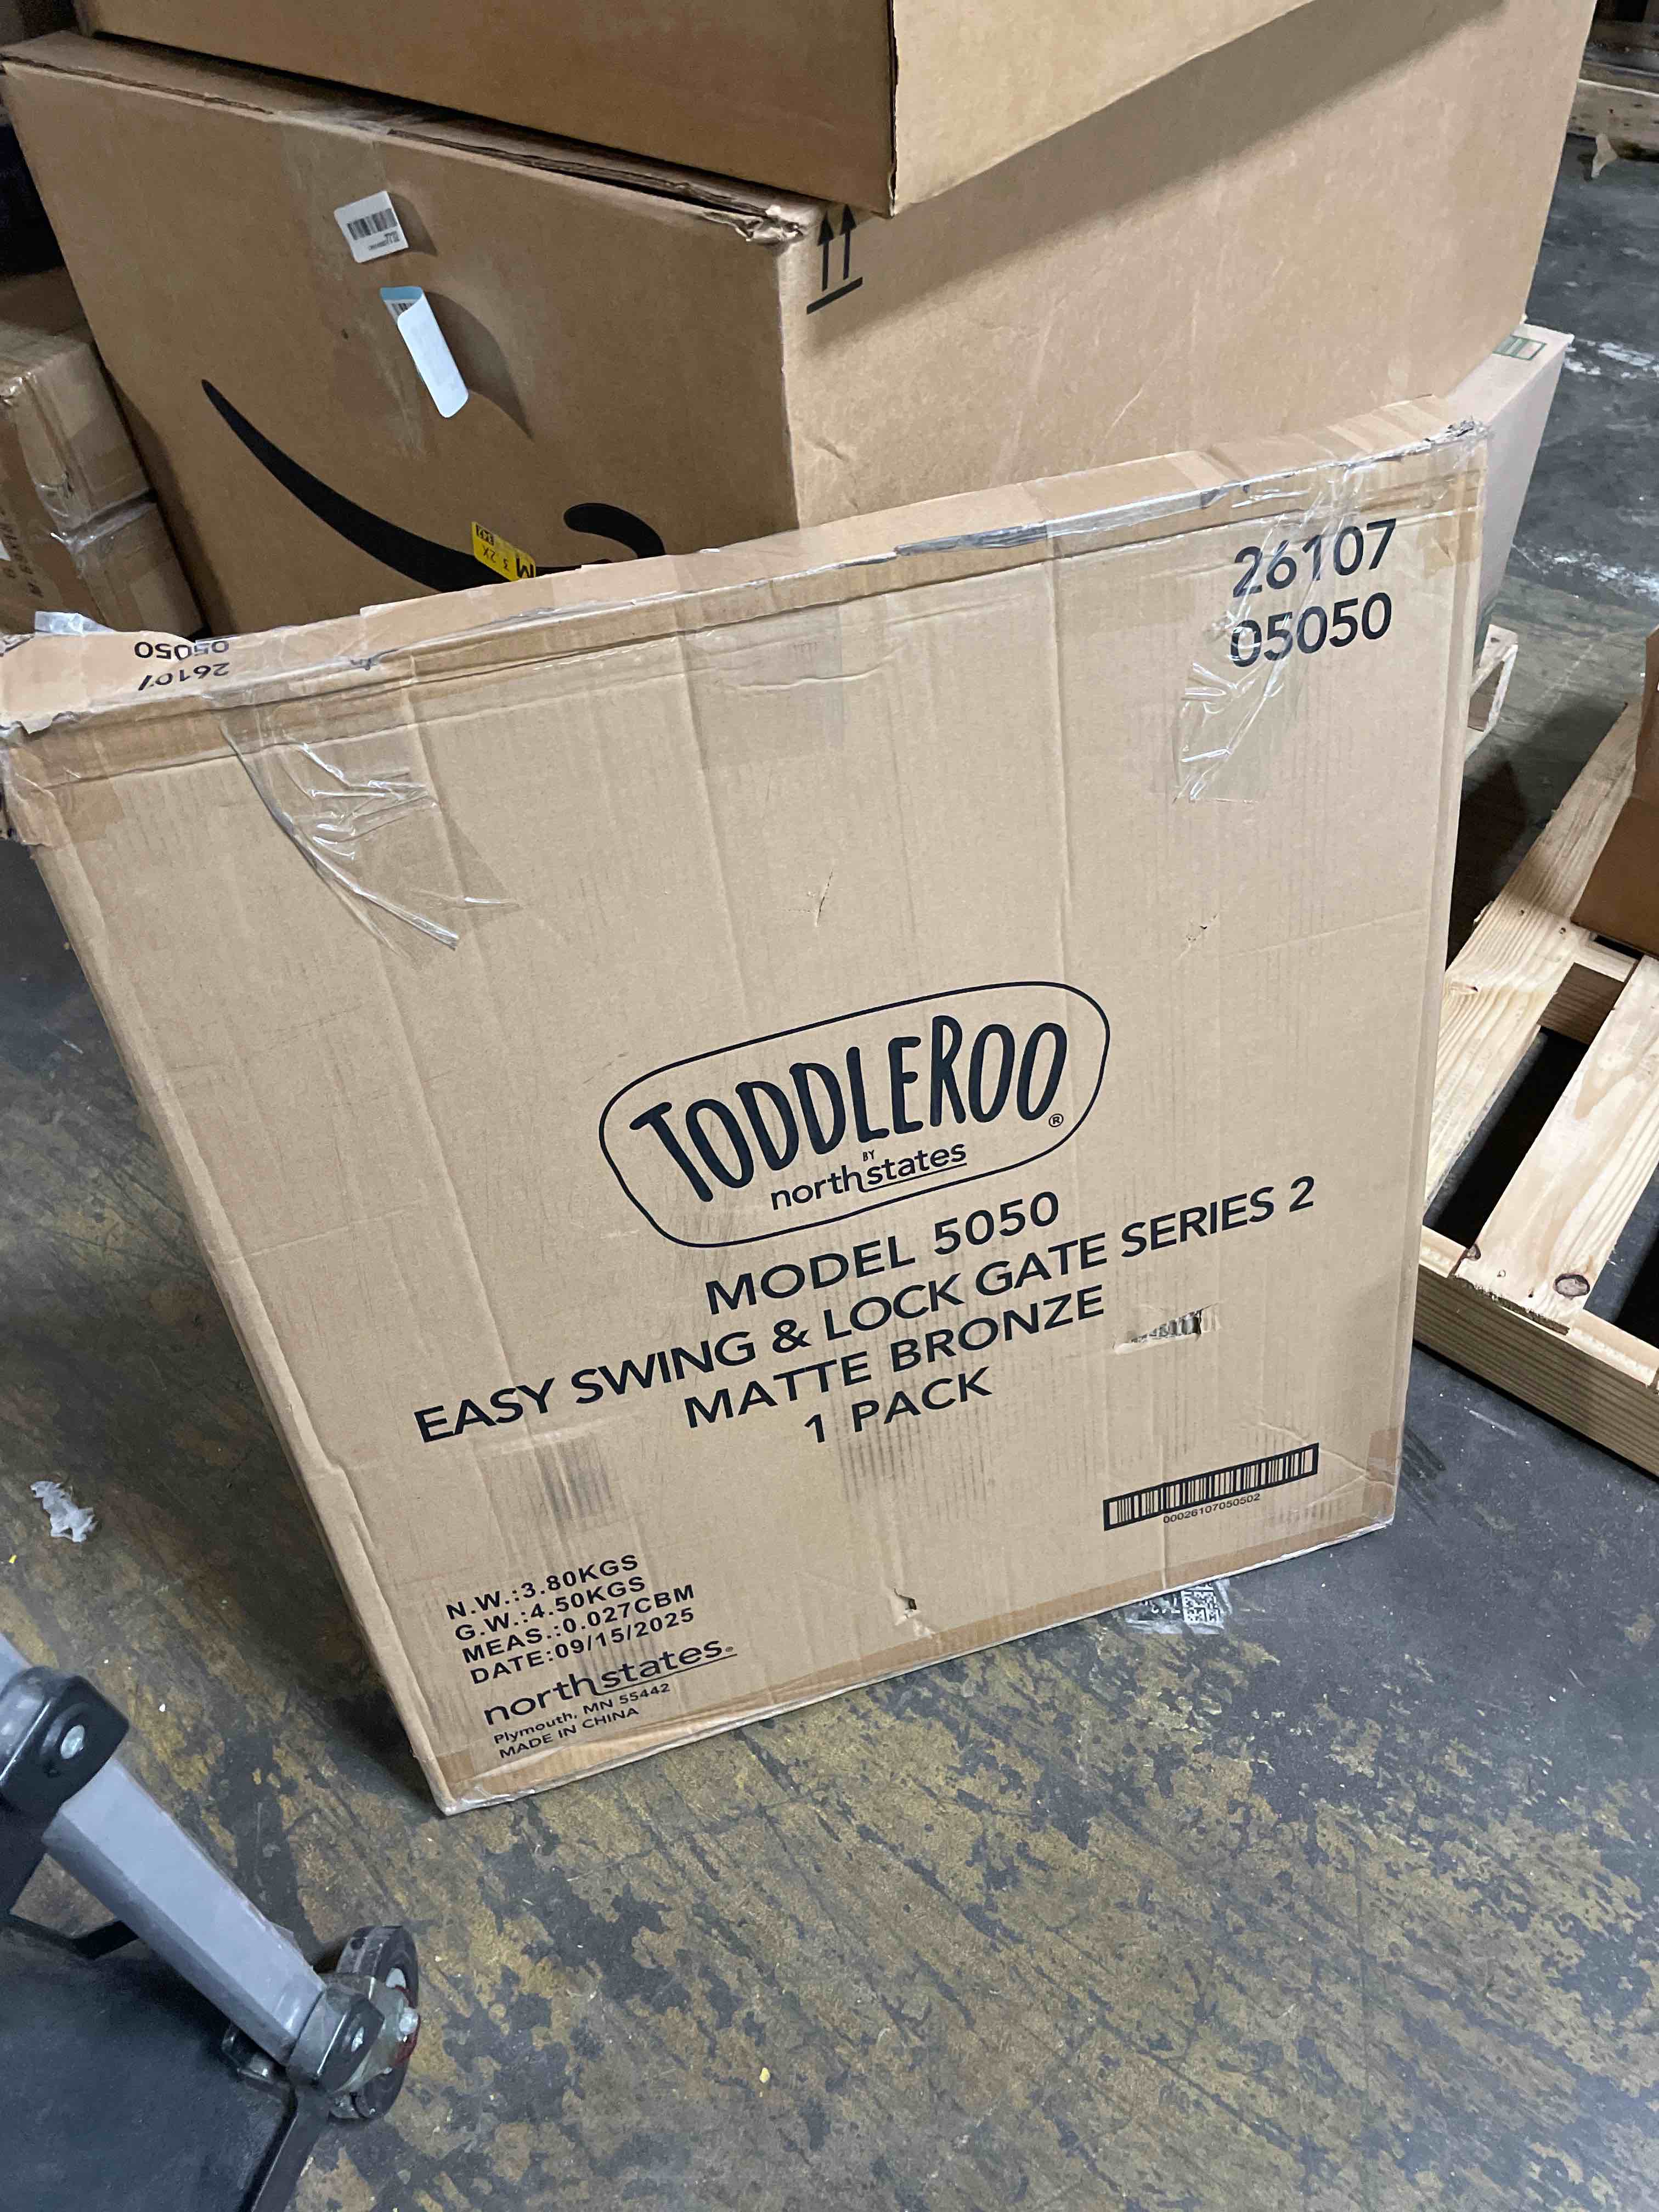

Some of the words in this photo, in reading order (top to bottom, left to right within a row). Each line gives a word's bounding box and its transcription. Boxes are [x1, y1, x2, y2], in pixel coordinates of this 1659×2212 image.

[1233, 518, 1396, 599] 26107
[1230, 592, 1392, 668] 05050
[629, 1015, 1068, 1203] TODDLEROO
[862, 1149, 876, 1162] BY
[706, 1235, 916, 1315] MODEL
[934, 1191, 1059, 1255] 5050
[414, 1377, 555, 1443] EASY
[570, 1331, 757, 1404] SWING
[772, 1319, 812, 1353] &
[823, 1272, 964, 1342] LOCK
[975, 1232, 1108, 1296] GATE
[1120, 1186, 1275, 1257] SERIES
[1289, 1176, 1314, 1213] 2
[684, 1351, 872, 1429] MATTE
[890, 1284, 1104, 1373] BRONZE
[804, 1413, 825, 1443] 1
[851, 1366, 993, 1433] PACK
[1163, 1492, 1261, 1524] 00026107050502
[494, 1710, 578, 1745] Plymouth,
[583, 1699, 613, 1716] MN
[619, 1683, 670, 1705] 55442
[499, 1734, 554, 1759] MADE
[558, 1724, 577, 1739] IN
[582, 1707, 640, 1729] CHINA
